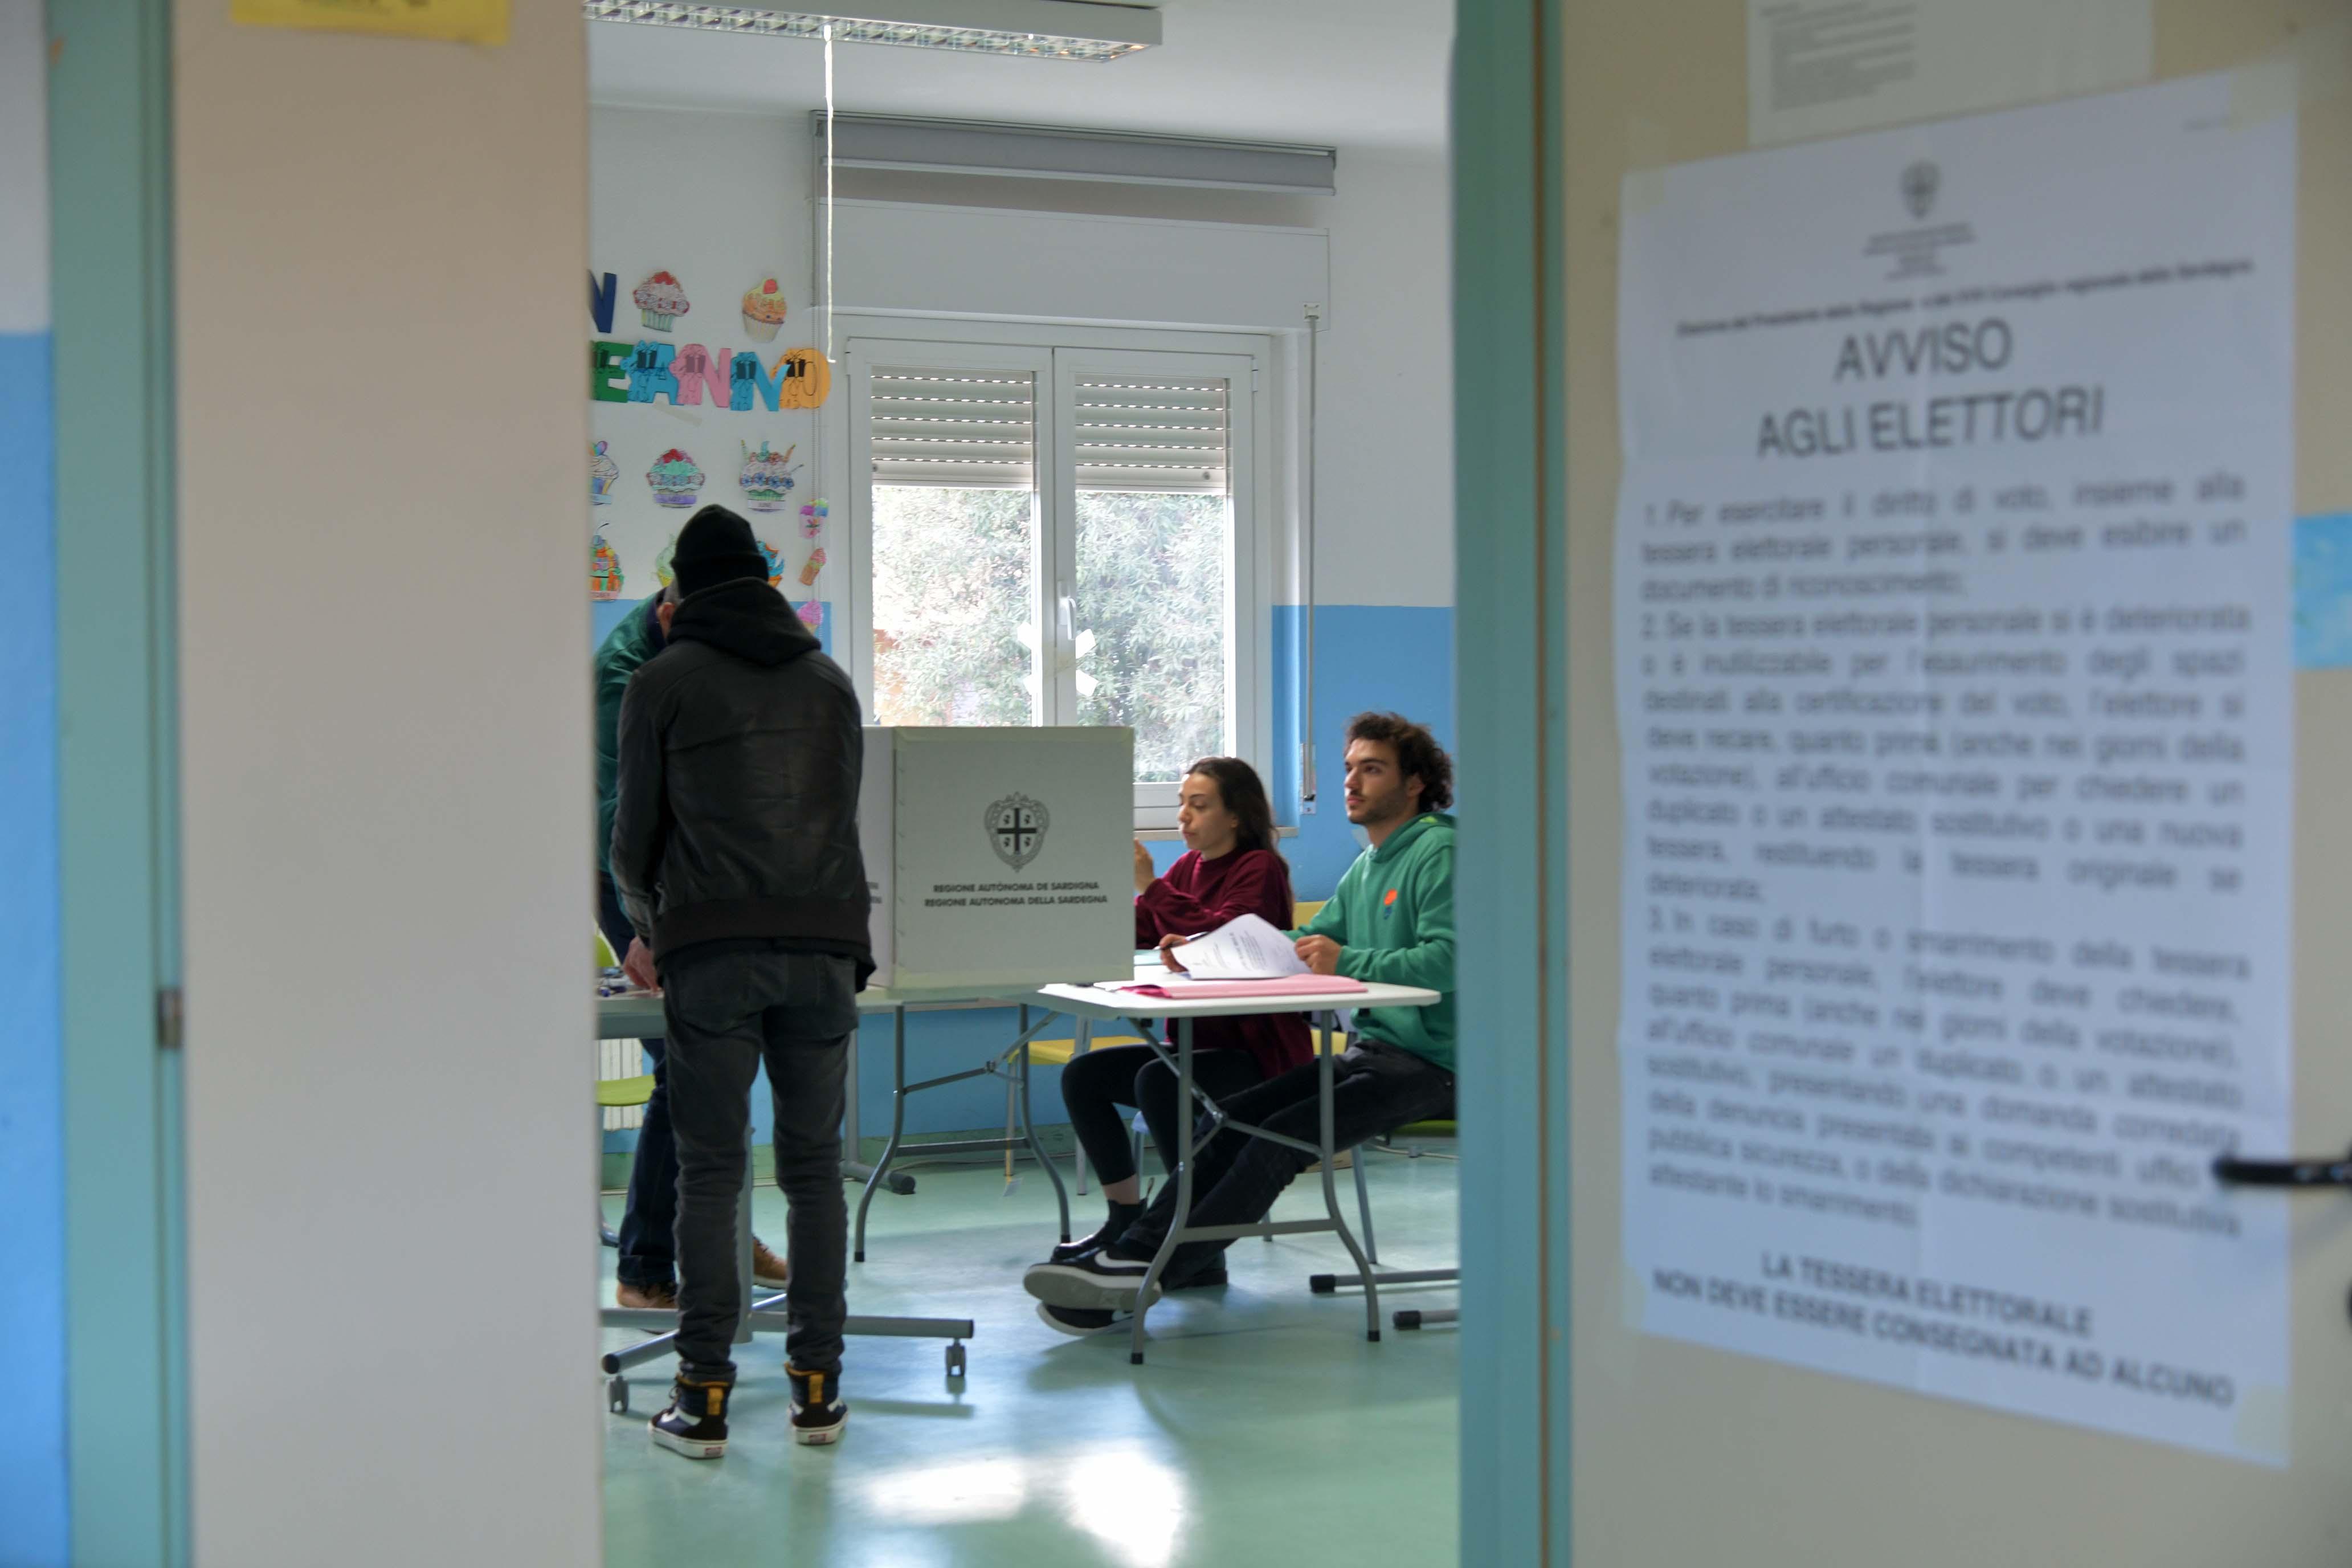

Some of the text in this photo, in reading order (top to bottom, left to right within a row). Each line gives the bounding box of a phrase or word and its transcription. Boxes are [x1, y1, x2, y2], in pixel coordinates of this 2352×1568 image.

[1835, 318, 2014, 378] AVVISO
[1757, 387, 2105, 457] AGLI ELETTORI
[924, 895, 1108, 907] REGIONE AUTONOMA DELLA SARDEGNA
[933, 884, 975, 893] REGIONE
[1051, 881, 1099, 891] SARDIGNA
[1762, 1254, 2092, 1336] LA TESSERA ELETTORALE
[1652, 1269, 2234, 1406] NON DEVE ESSERE CONSEGNATA AD ALCUNO
